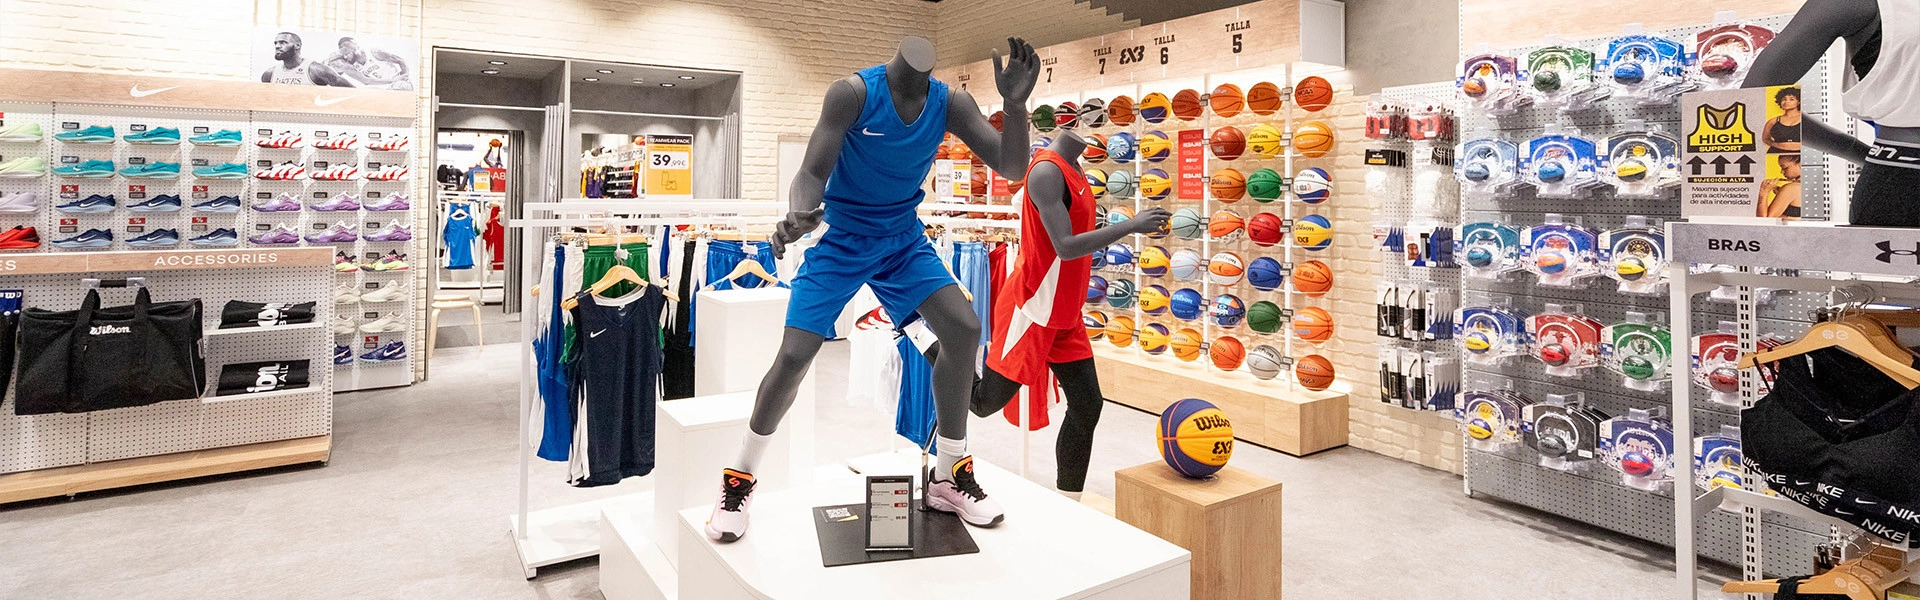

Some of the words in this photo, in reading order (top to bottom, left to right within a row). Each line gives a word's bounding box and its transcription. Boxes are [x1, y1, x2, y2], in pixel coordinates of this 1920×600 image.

[1225, 20, 1251, 33] TALLA
[1154, 34, 1176, 46] TALLA
[1232, 33, 1242, 54] 5
[1093, 46, 1112, 57] TALLA
[1160, 46, 1169, 65] 6
[1042, 57, 1058, 66] TALLA
[1099, 57, 1106, 75] 7
[1046, 67, 1053, 83] 7
[1699, 133, 1743, 144] HIGH
[1708, 238, 1761, 252] BRAS
[0, 259, 17, 271] S
[154, 253, 278, 266] ACCESSORIES
[89, 325, 131, 336] Wilson
[1780, 486, 1811, 505] NIKE
[1861, 518, 1906, 543] NIKE
